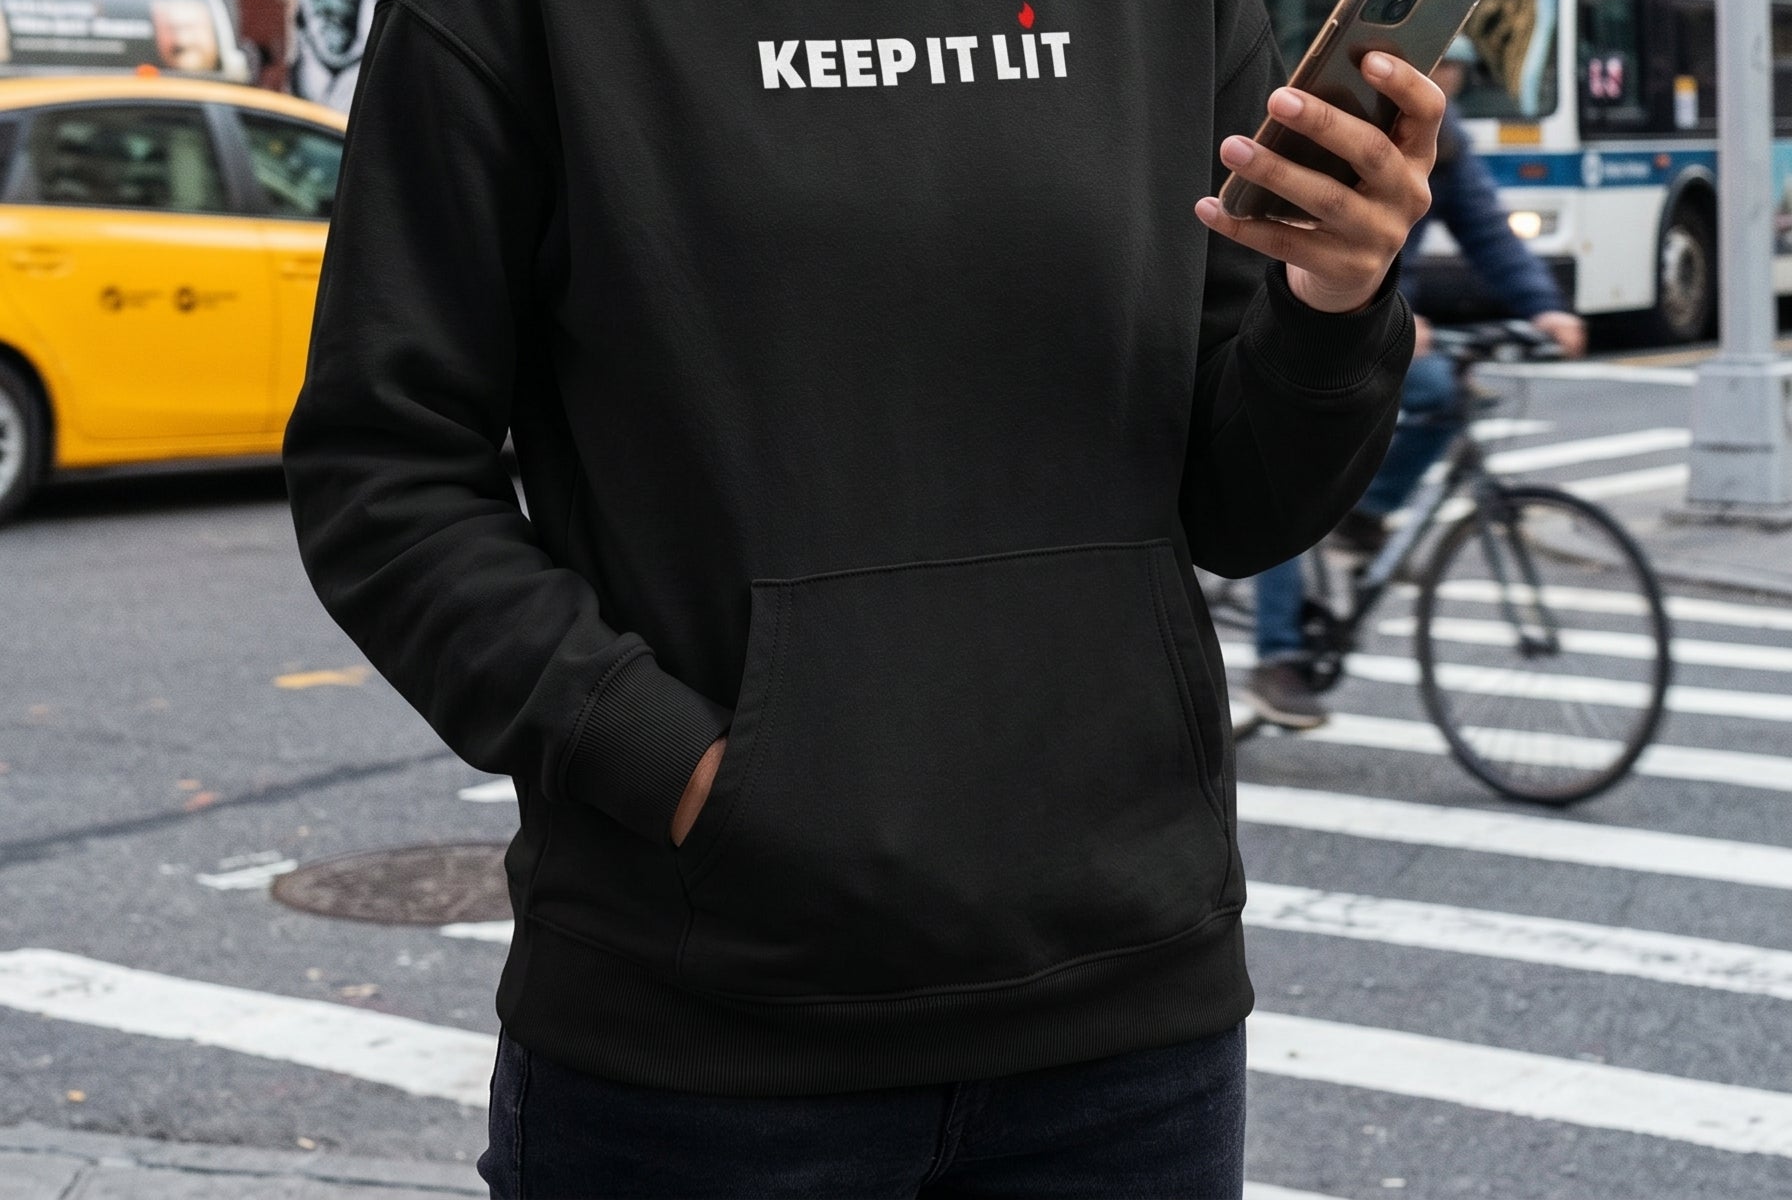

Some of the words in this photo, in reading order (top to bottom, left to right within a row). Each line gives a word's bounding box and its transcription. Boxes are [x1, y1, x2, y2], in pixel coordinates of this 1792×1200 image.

[757, 38, 917, 89] KEEP
[926, 36, 979, 84] IT
[992, 32, 1071, 80] LIT
